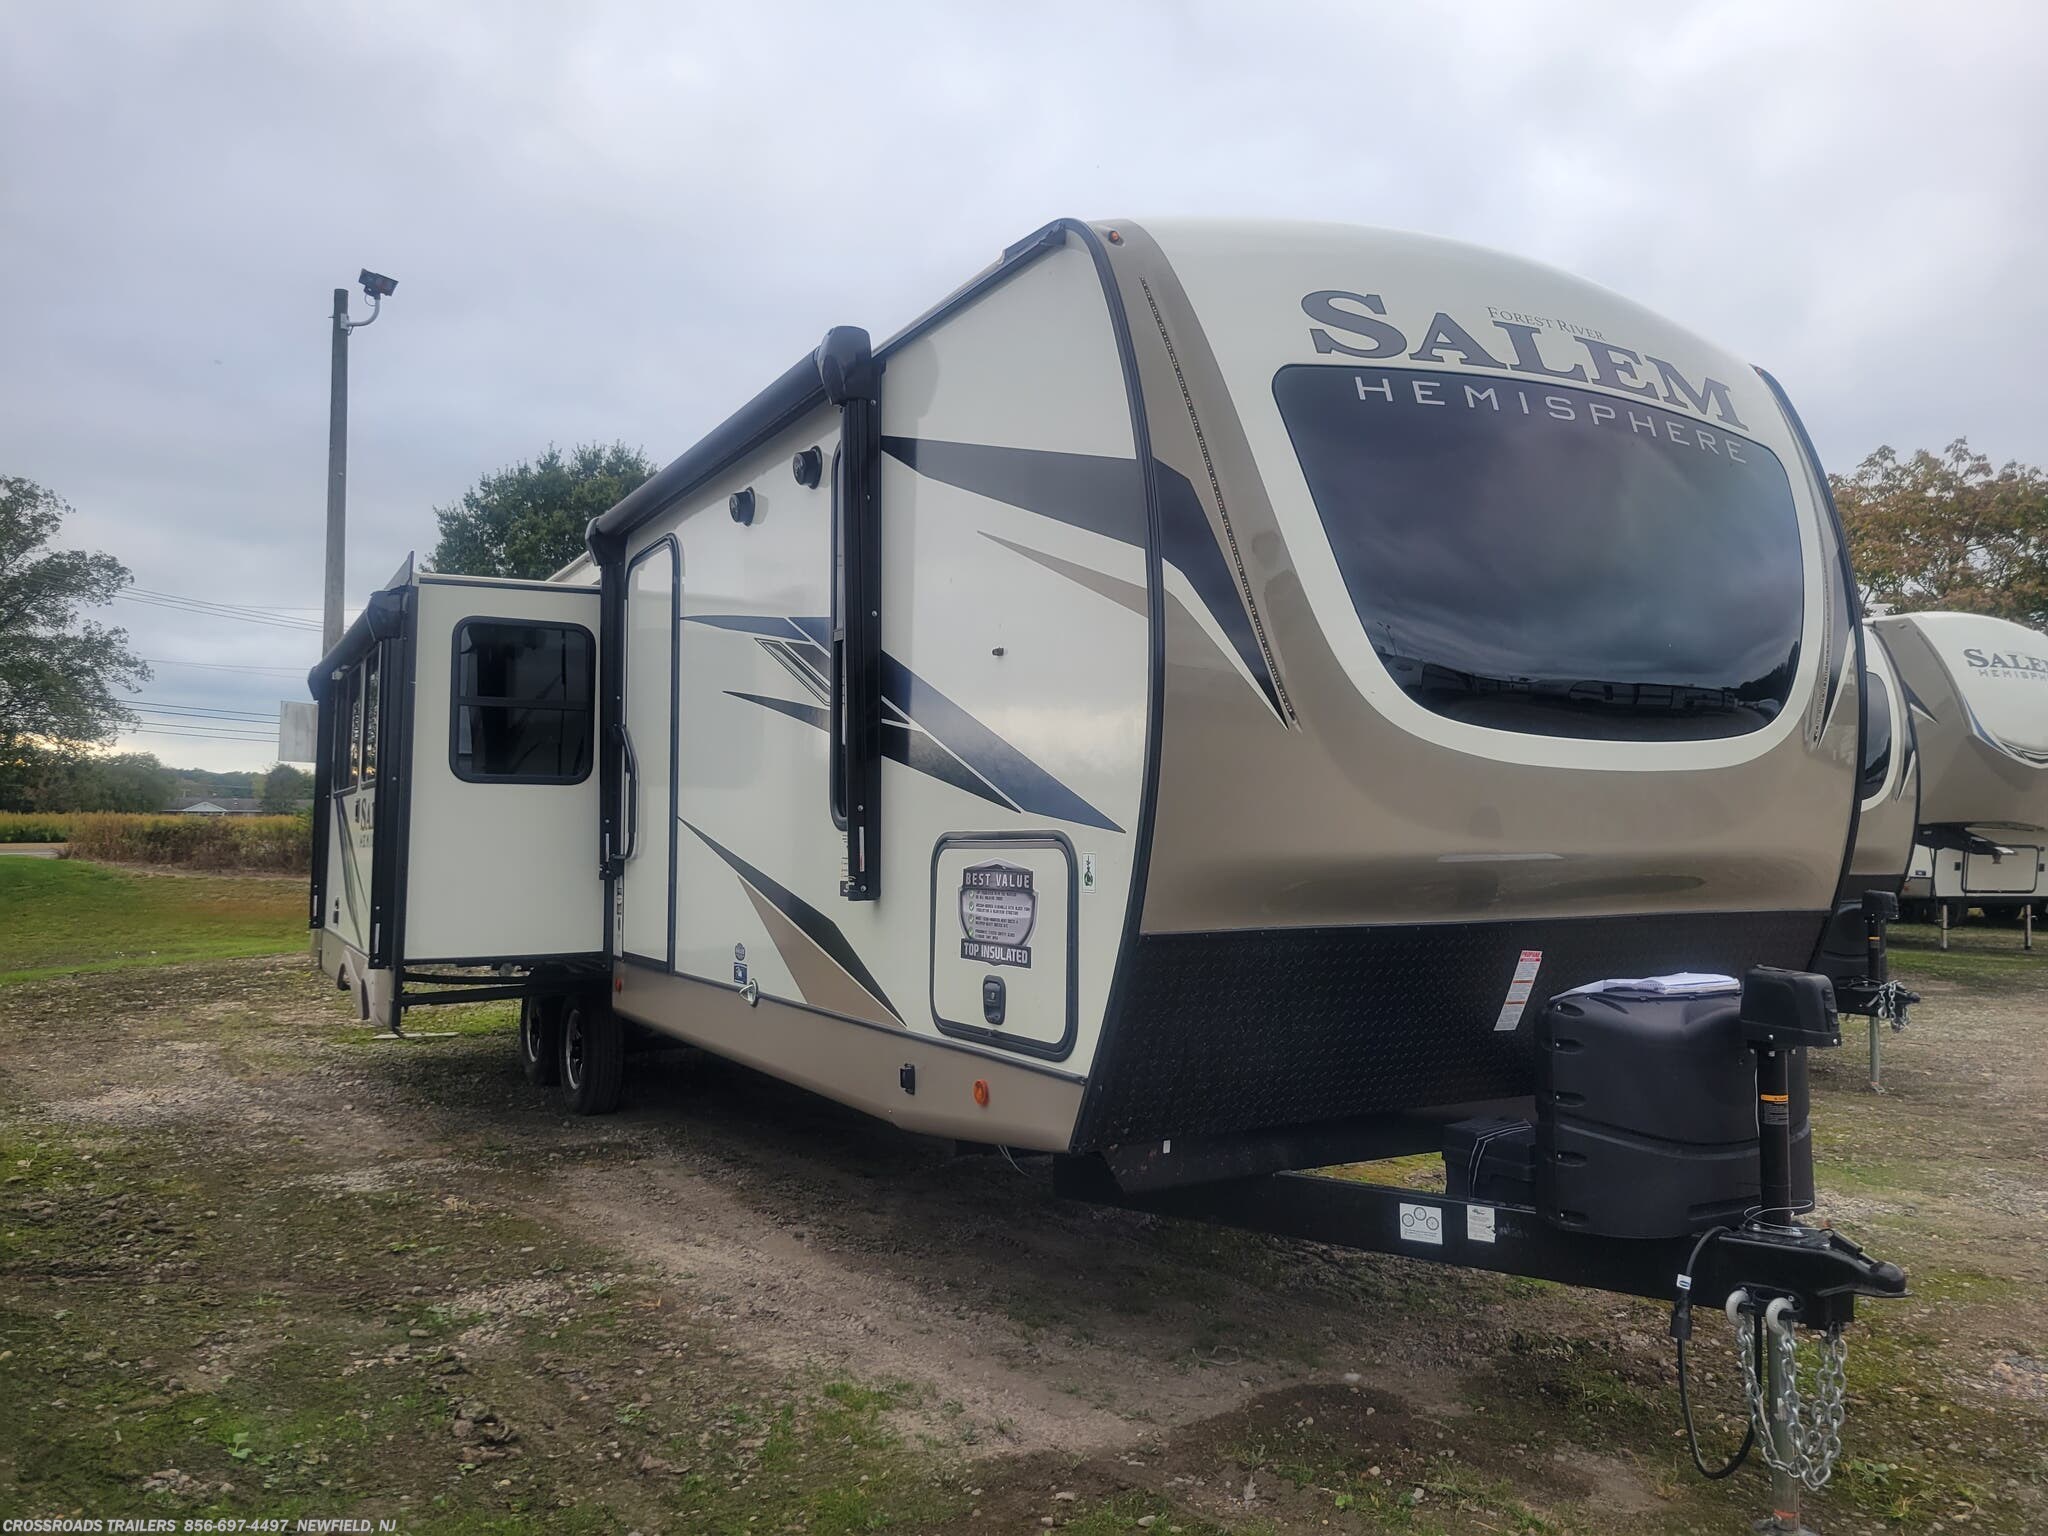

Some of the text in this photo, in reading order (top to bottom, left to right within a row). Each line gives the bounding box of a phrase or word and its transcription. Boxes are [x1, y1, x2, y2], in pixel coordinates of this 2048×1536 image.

[1487, 305, 1607, 342] FOREST RIVER
[1300, 289, 1750, 432] SALEM
[1354, 376, 1749, 465] HEMISPHERE
[965, 872, 1030, 889] BEST VALUE
[963, 942, 1028, 963] TOP INSULATED
